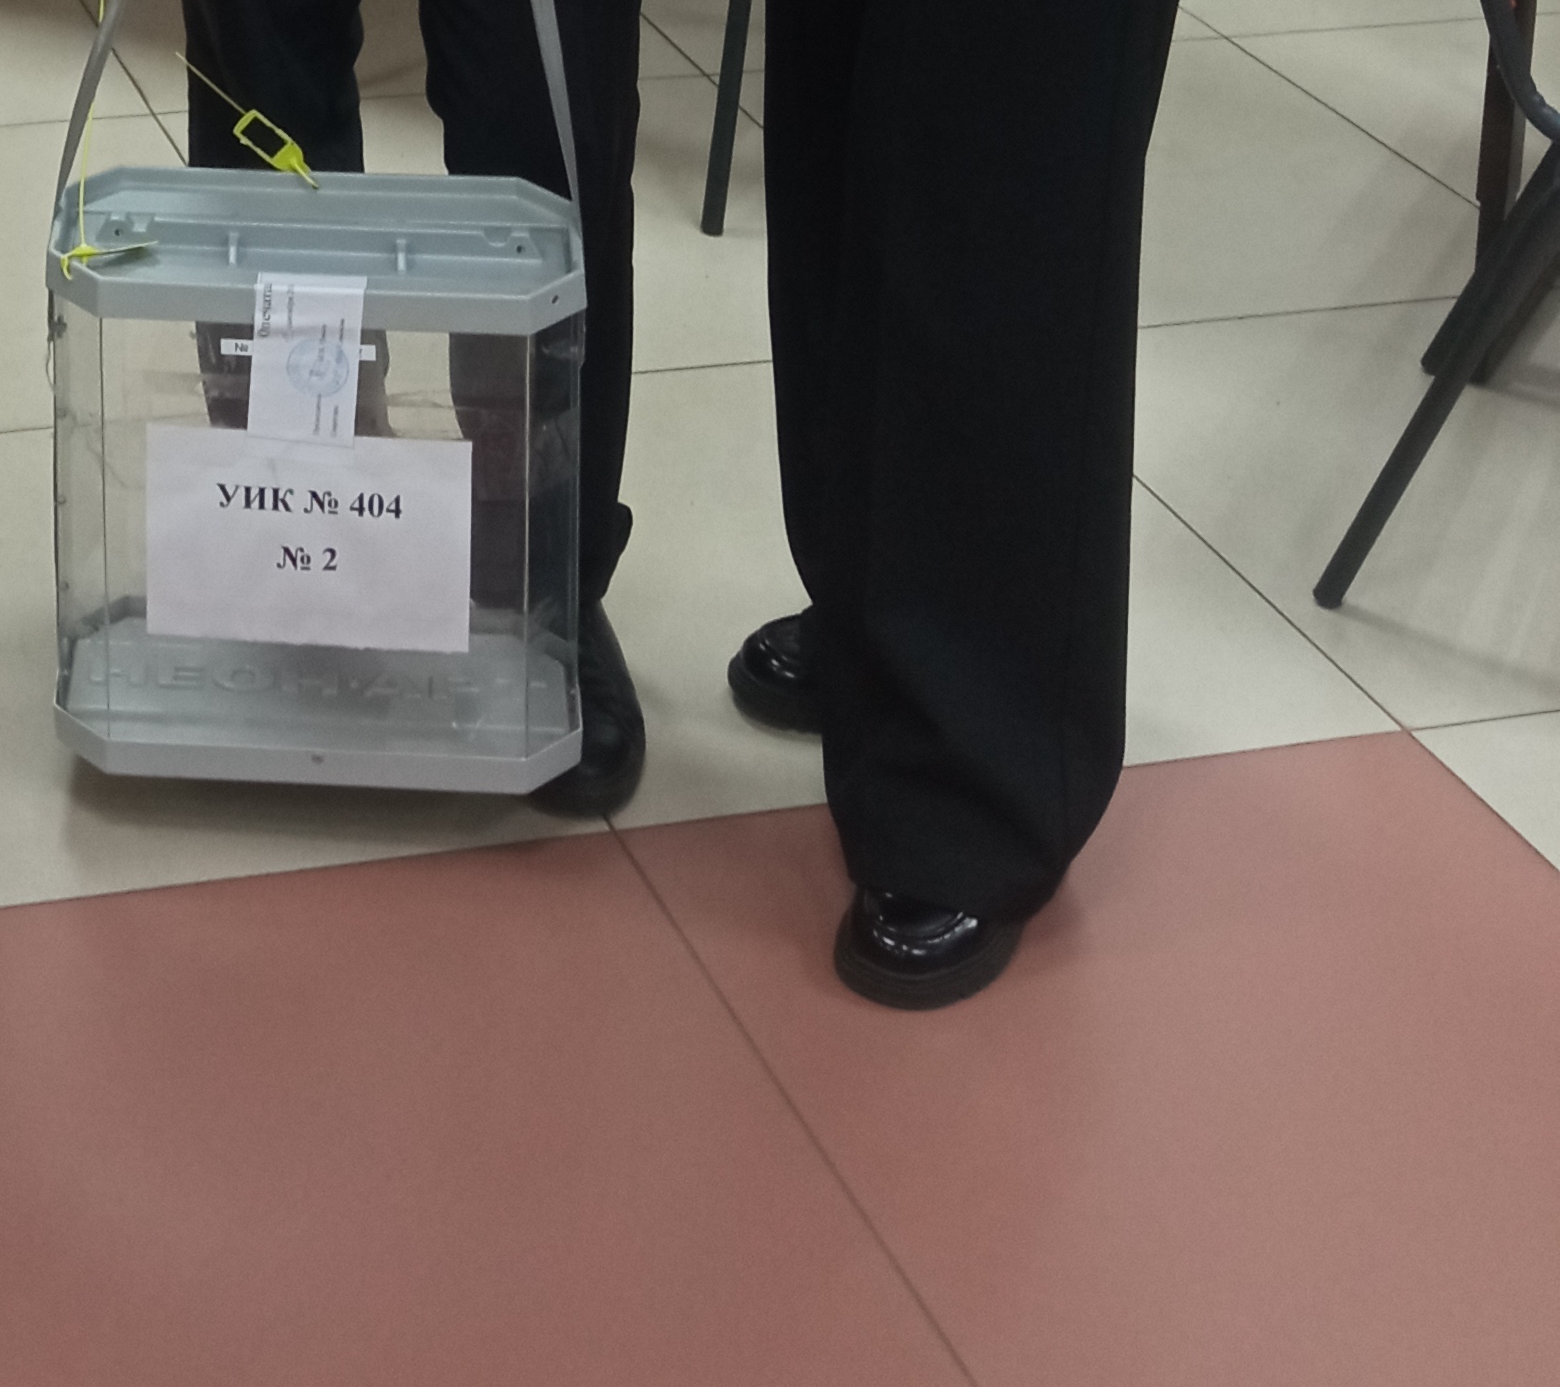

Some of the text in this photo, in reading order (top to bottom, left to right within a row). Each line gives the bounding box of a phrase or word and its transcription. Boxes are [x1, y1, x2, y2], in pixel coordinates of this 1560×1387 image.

[216, 482, 403, 519] УИК № 404
[276, 545, 338, 571] № 2
